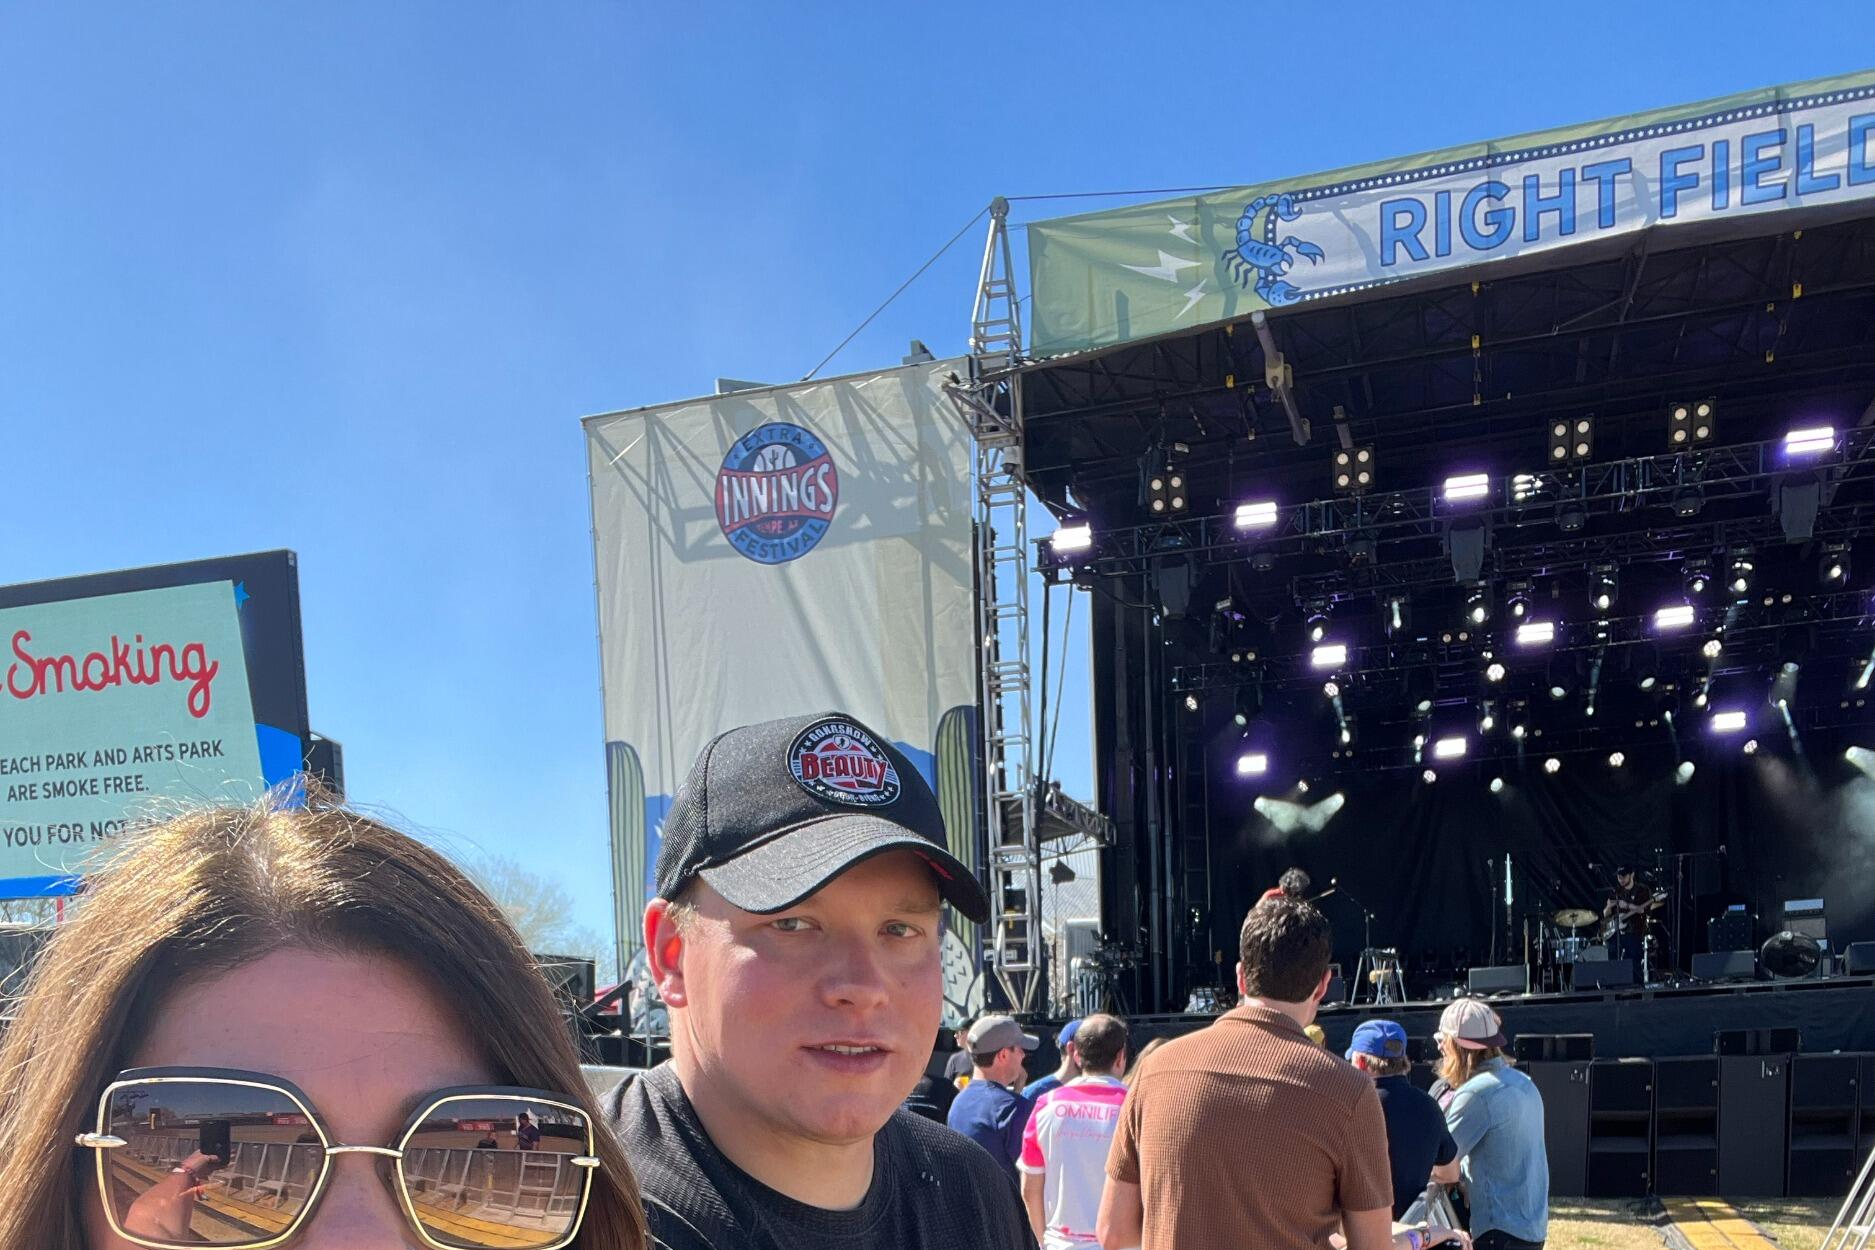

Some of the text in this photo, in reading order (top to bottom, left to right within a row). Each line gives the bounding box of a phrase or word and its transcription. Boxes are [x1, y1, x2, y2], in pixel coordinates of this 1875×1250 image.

[1380, 114, 1875, 267] RIGHT FIELD
[742, 428, 803, 452] EXTRA
[721, 463, 834, 527] INNINGS
[734, 523, 824, 559] FESTIVAL
[7, 630, 219, 718] Smoking
[46, 752, 88, 771] PARK
[94, 748, 127, 767] AND
[132, 744, 174, 763] ARTS
[179, 739, 225, 759] PARK
[800, 752, 889, 791] BEAUTY
[7, 774, 149, 801] ARE SMOKE FREE.
[3, 826, 41, 848] YOU
[47, 823, 84, 844] FOR
[1055, 1104, 1121, 1121] OMNILIF
